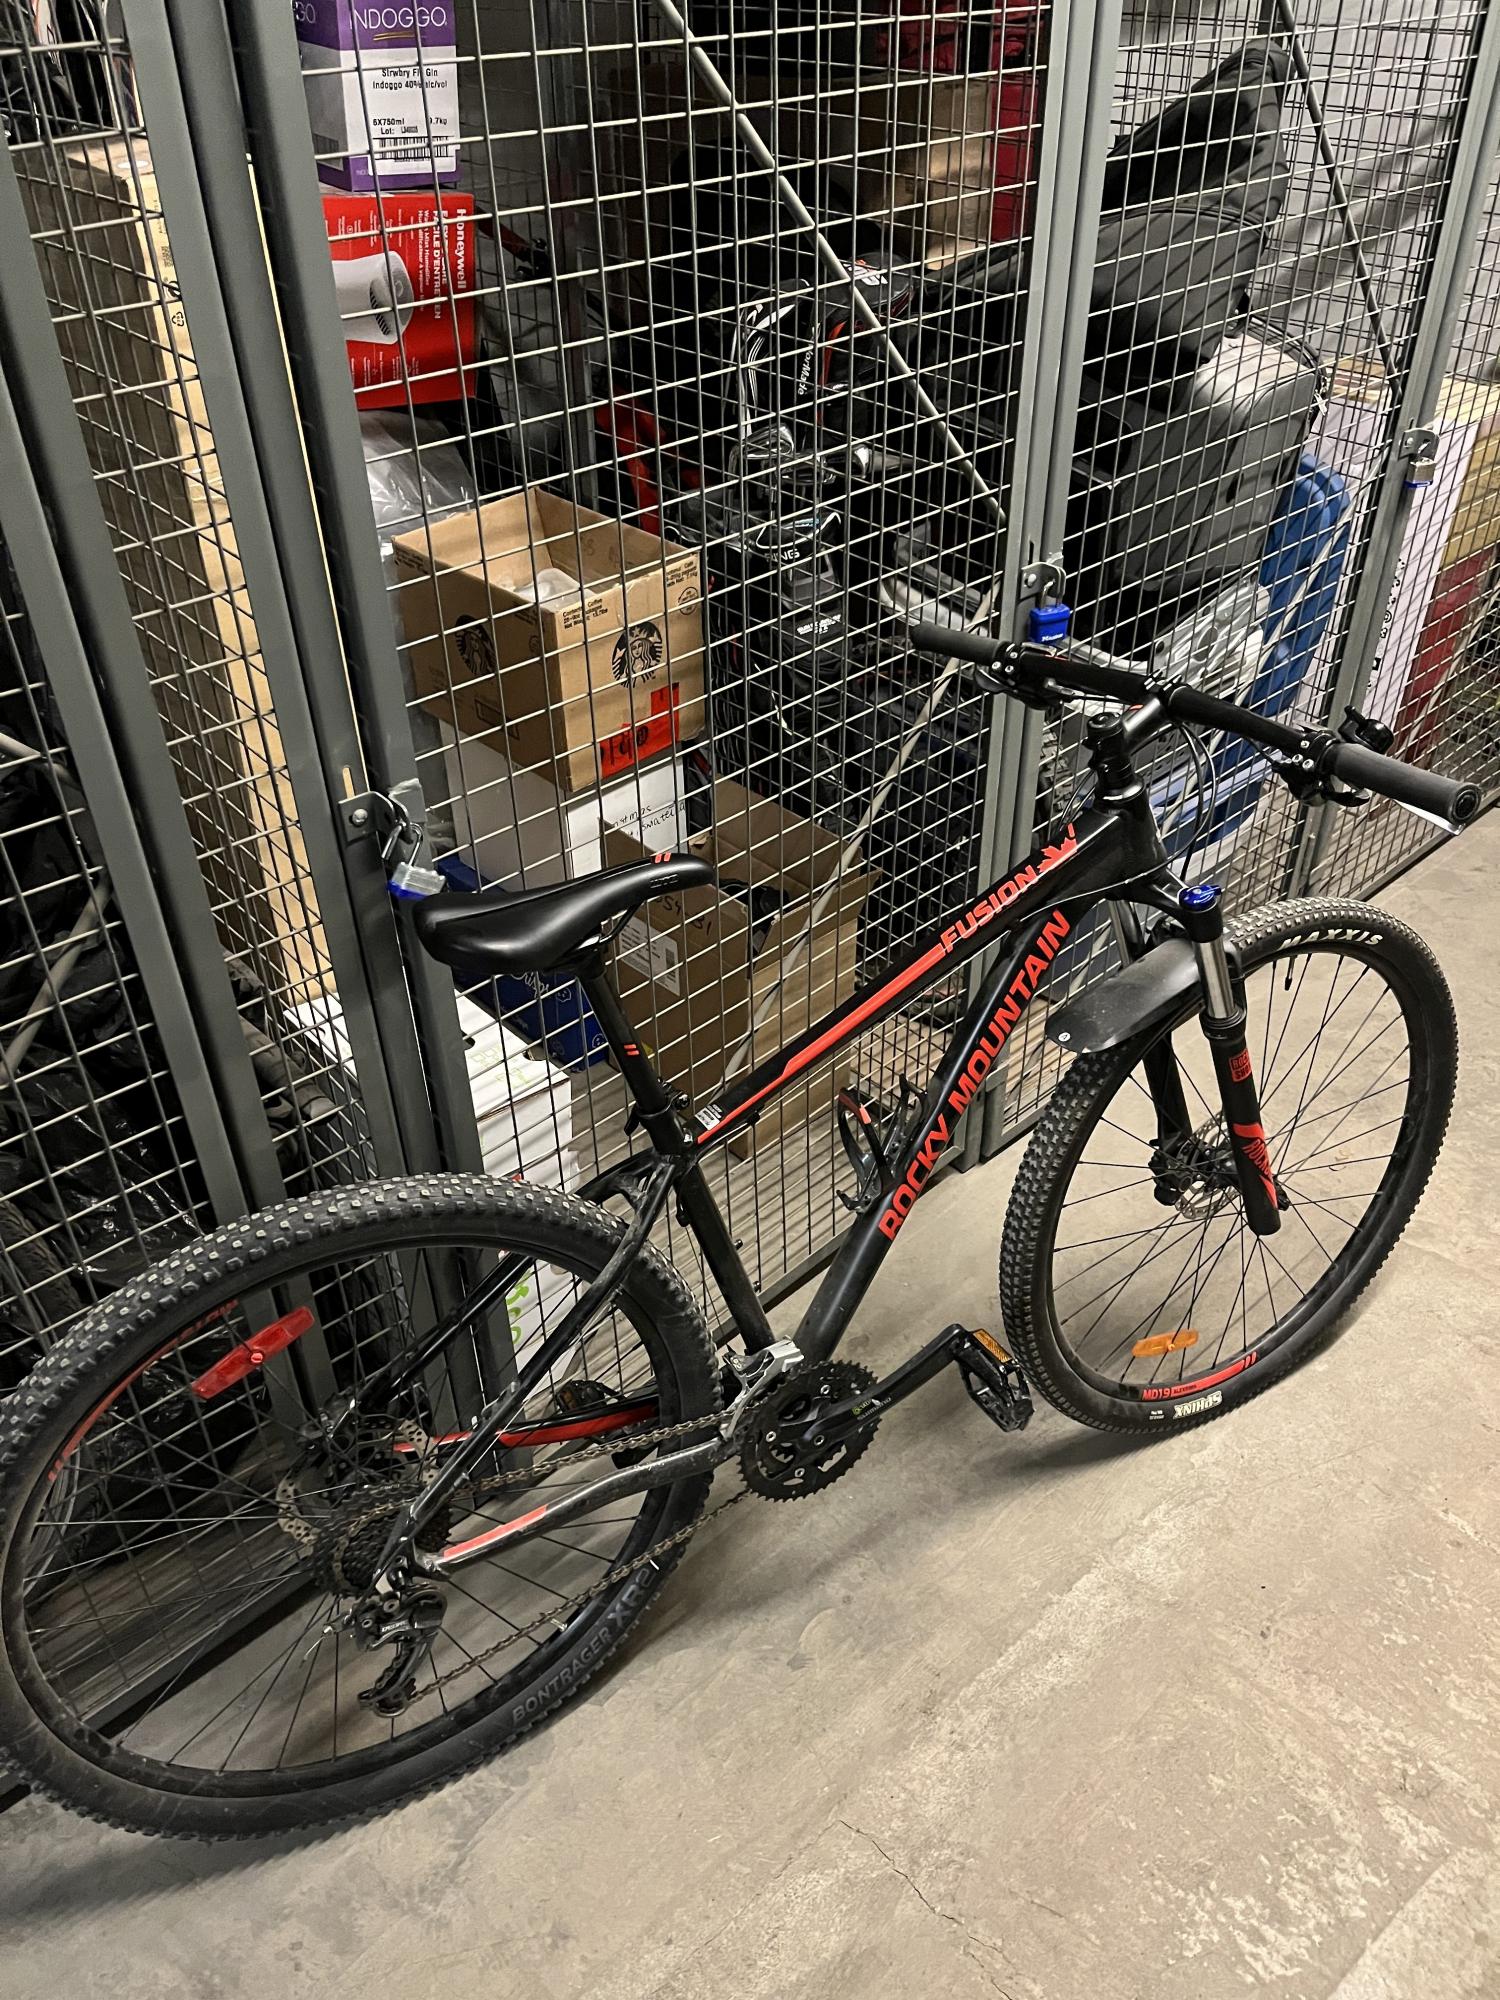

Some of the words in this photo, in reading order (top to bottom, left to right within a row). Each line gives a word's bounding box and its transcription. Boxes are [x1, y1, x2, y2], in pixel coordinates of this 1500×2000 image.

[373, 81, 402, 90] Indoggo
[454, 208, 467, 289] Honeywell
[940, 864, 1039, 953] FUSION
[1276, 929, 1383, 951] MAXXIS
[878, 1113, 949, 1241] ROCKY
[948, 909, 1071, 1115] MOUNTAIN
[1142, 1388, 1171, 1401] MD19
[1173, 1390, 1223, 1419] SPHINX
[512, 1626, 612, 1723] BONTRAGER
